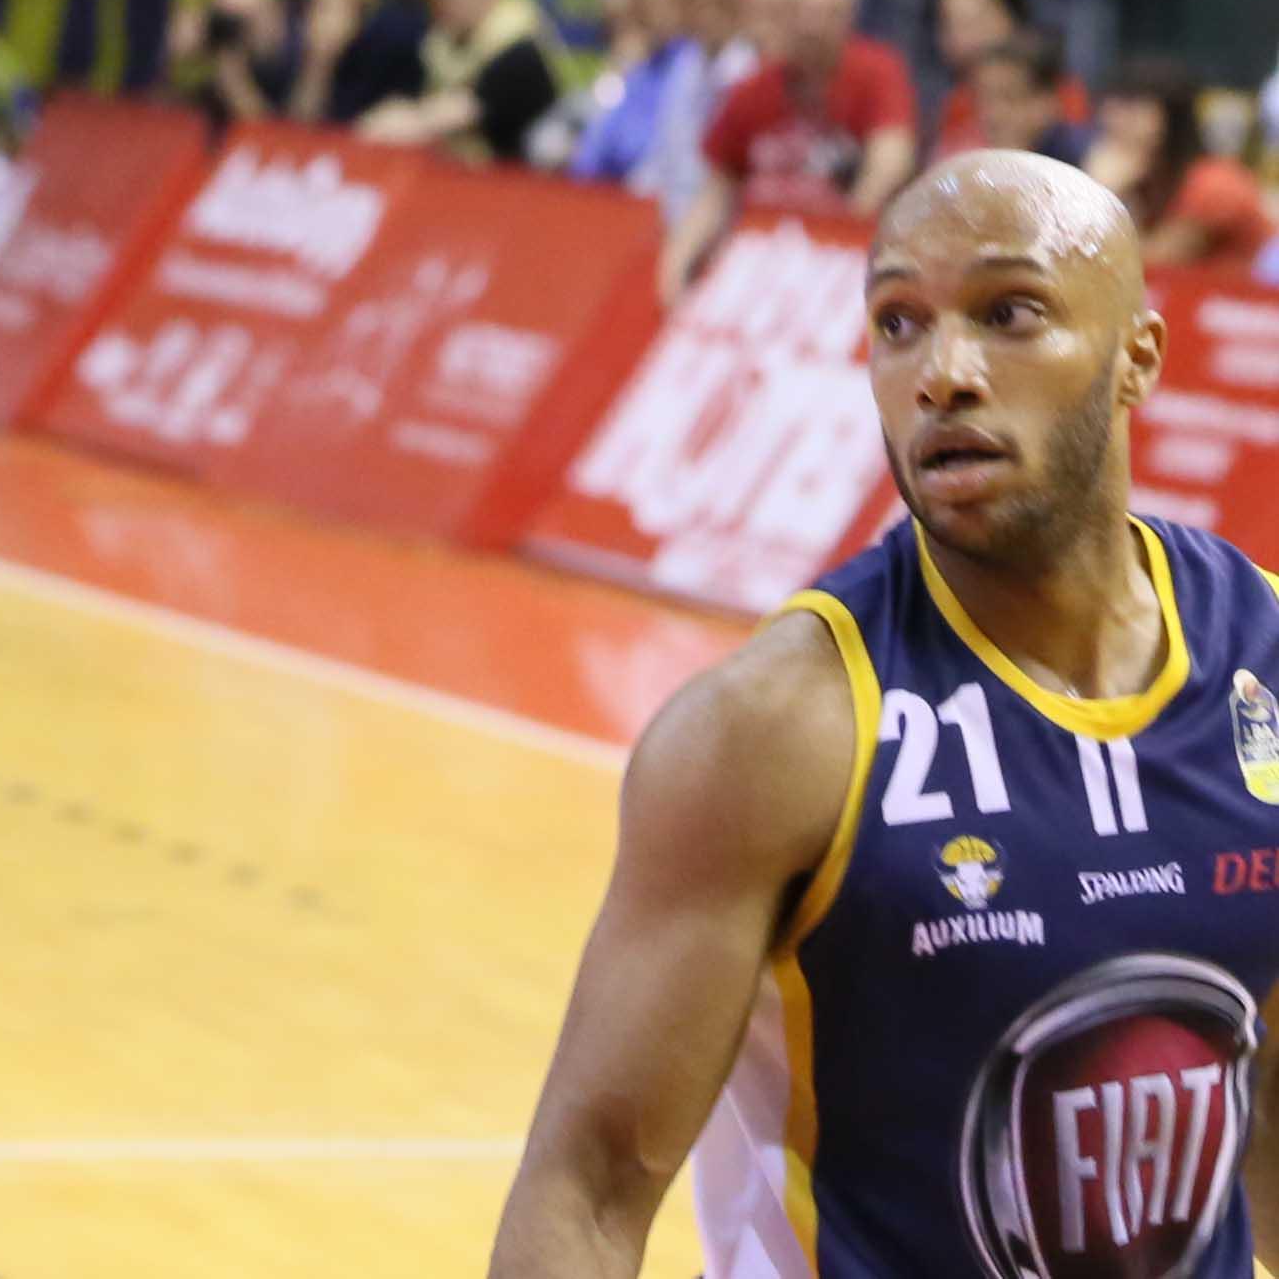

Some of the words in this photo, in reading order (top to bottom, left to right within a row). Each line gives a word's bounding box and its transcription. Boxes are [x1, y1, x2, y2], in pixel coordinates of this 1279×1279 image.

[878, 682, 1011, 826] 21
[1077, 861, 1185, 905] SPALDING
[1212, 848, 1279, 895] DE
[912, 909, 1045, 957] AUXILIUM
[1052, 1062, 1221, 1252] FIAT
